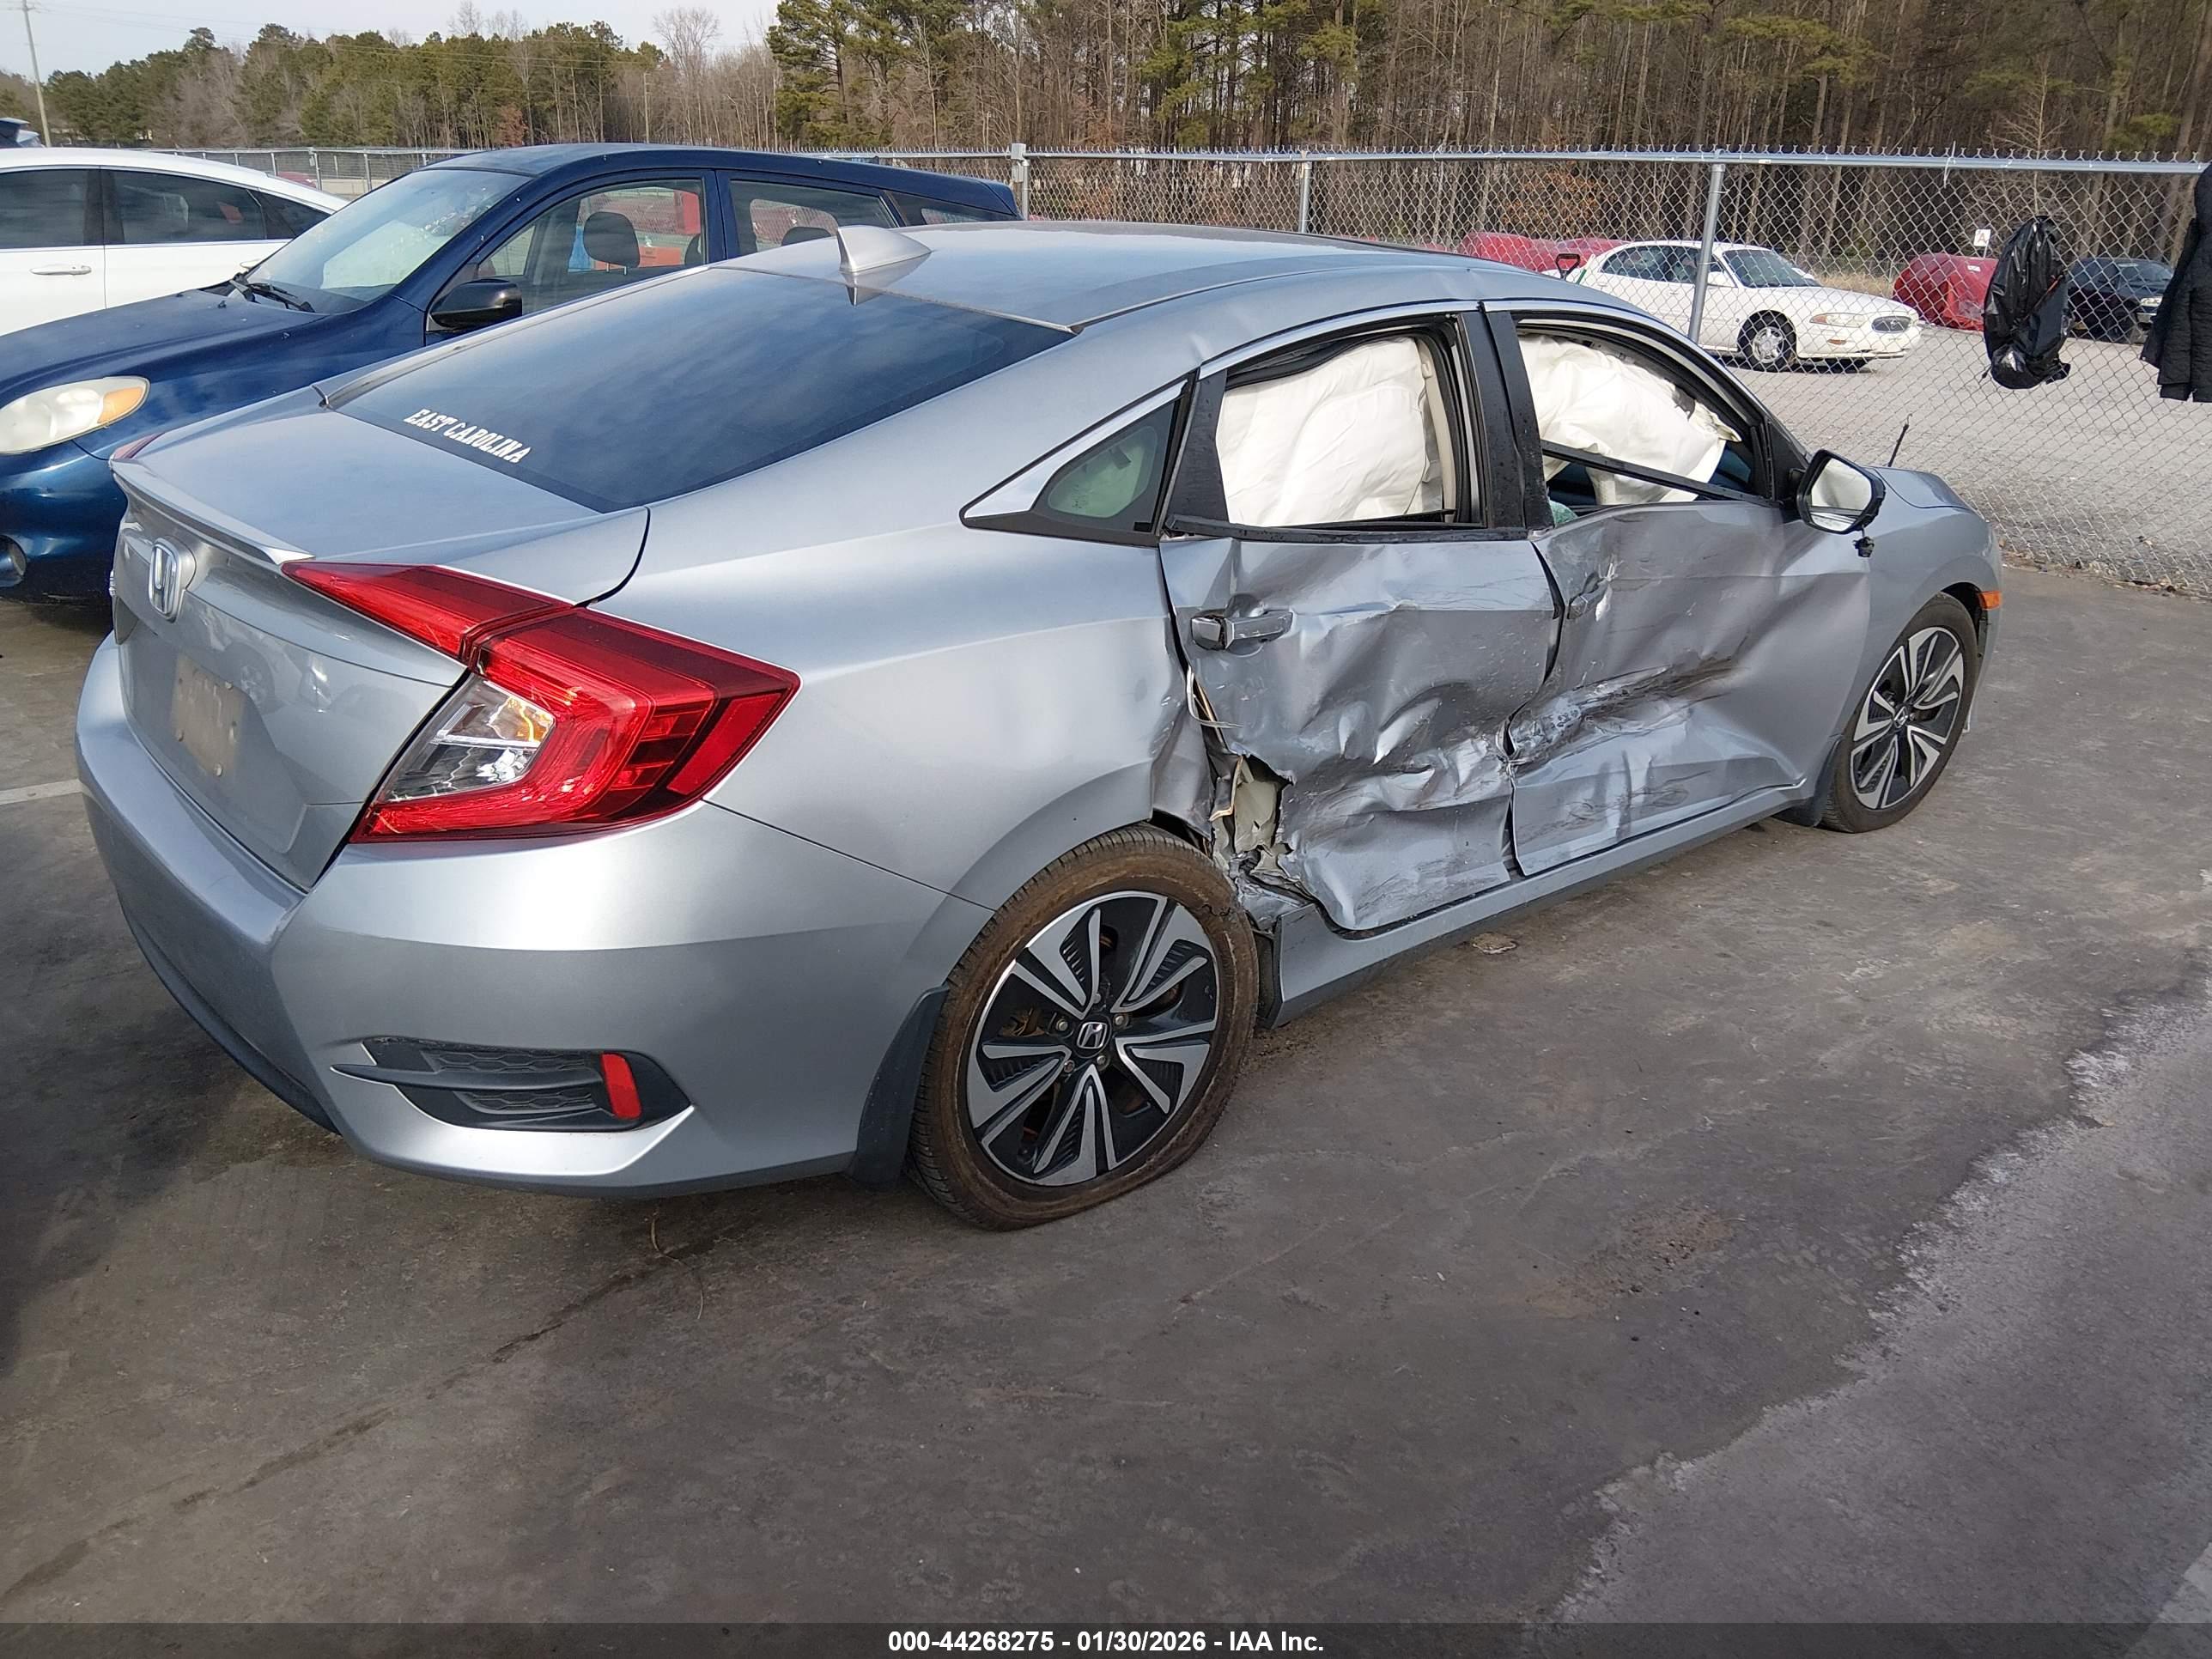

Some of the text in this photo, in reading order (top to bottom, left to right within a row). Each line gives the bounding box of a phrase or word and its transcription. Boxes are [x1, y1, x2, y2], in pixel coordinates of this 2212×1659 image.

[1978, 232, 1988, 244] A
[403, 408, 532, 464] EAST CAROLINA
